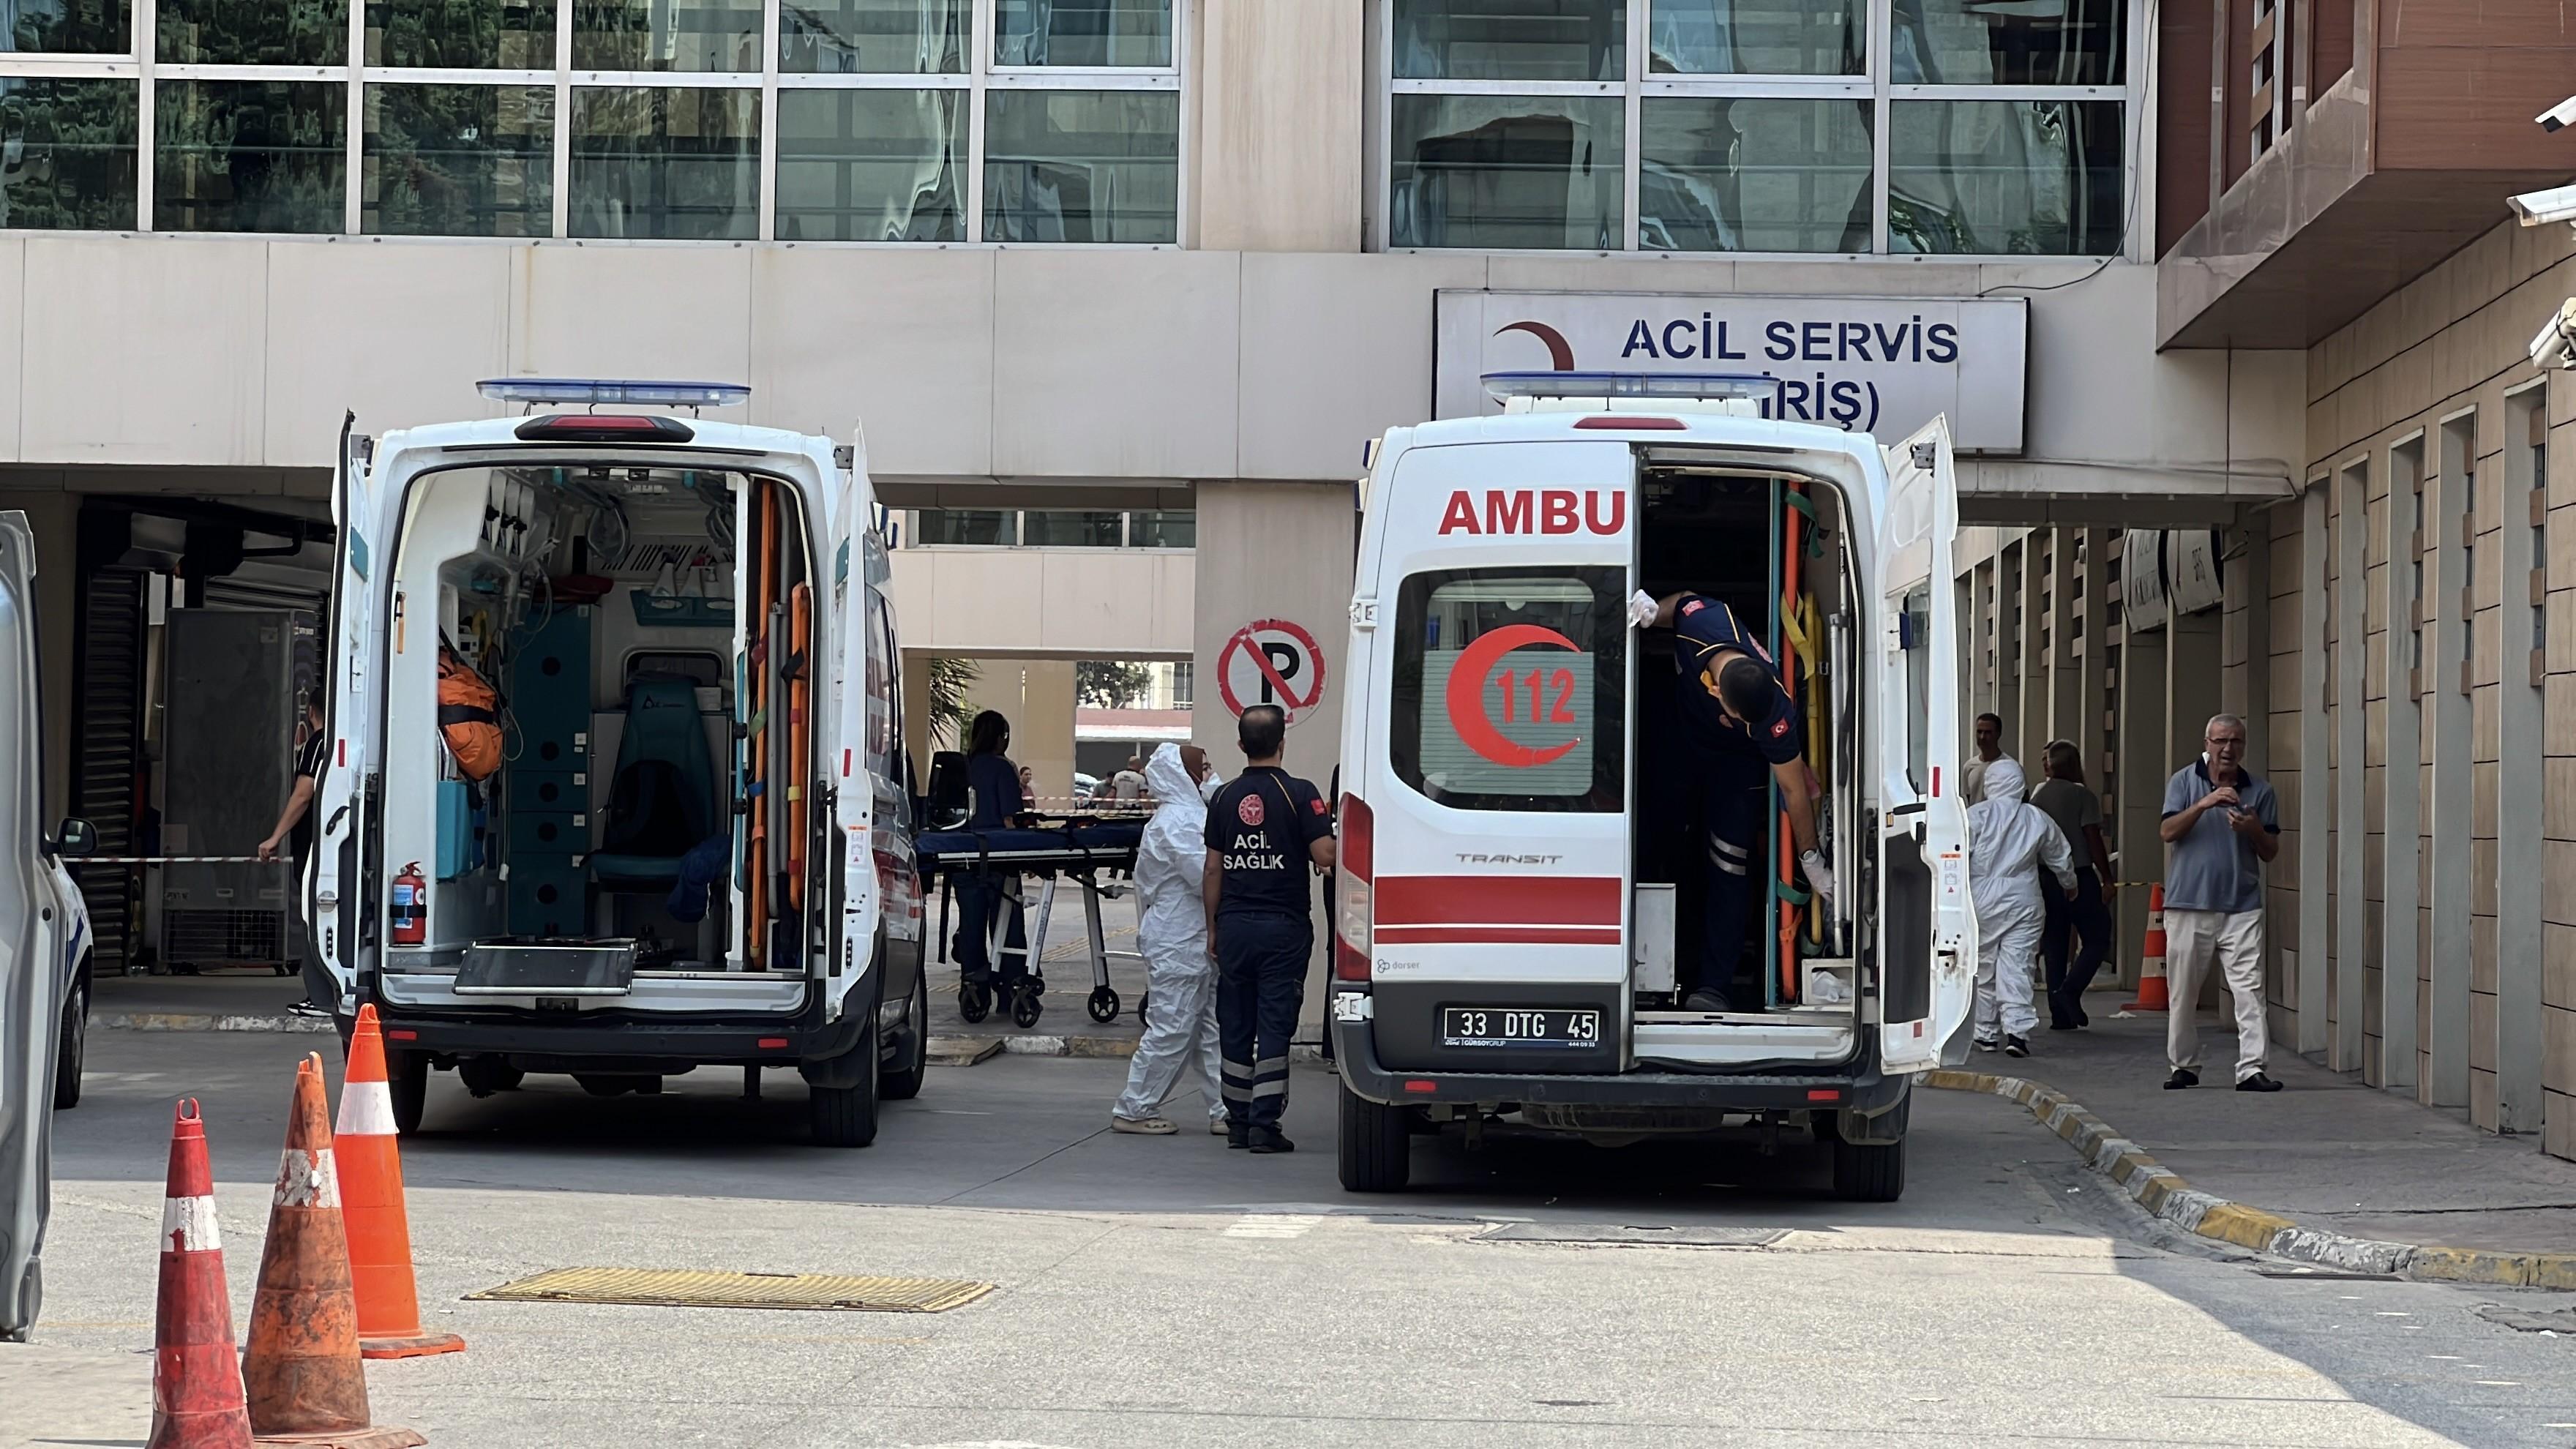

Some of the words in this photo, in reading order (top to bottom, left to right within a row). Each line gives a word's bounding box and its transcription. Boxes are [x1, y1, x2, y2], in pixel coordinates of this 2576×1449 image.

[1621, 312, 1746, 360] ACİL
[1764, 315, 1958, 363] SERVİS
[1762, 372, 1879, 433] İRİŞ)
[1438, 490, 1625, 535] AMBU
[1261, 643, 1300, 703] P
[1495, 667, 1576, 724] 112
[1223, 851, 1285, 869] SAĞLIK
[1234, 831, 1271, 849] ACİL
[1456, 853, 1563, 864] TRANSIT
[1461, 1013, 1487, 1036] 33
[1505, 1013, 1546, 1037] DTG
[1568, 1014, 1594, 1038] 45
